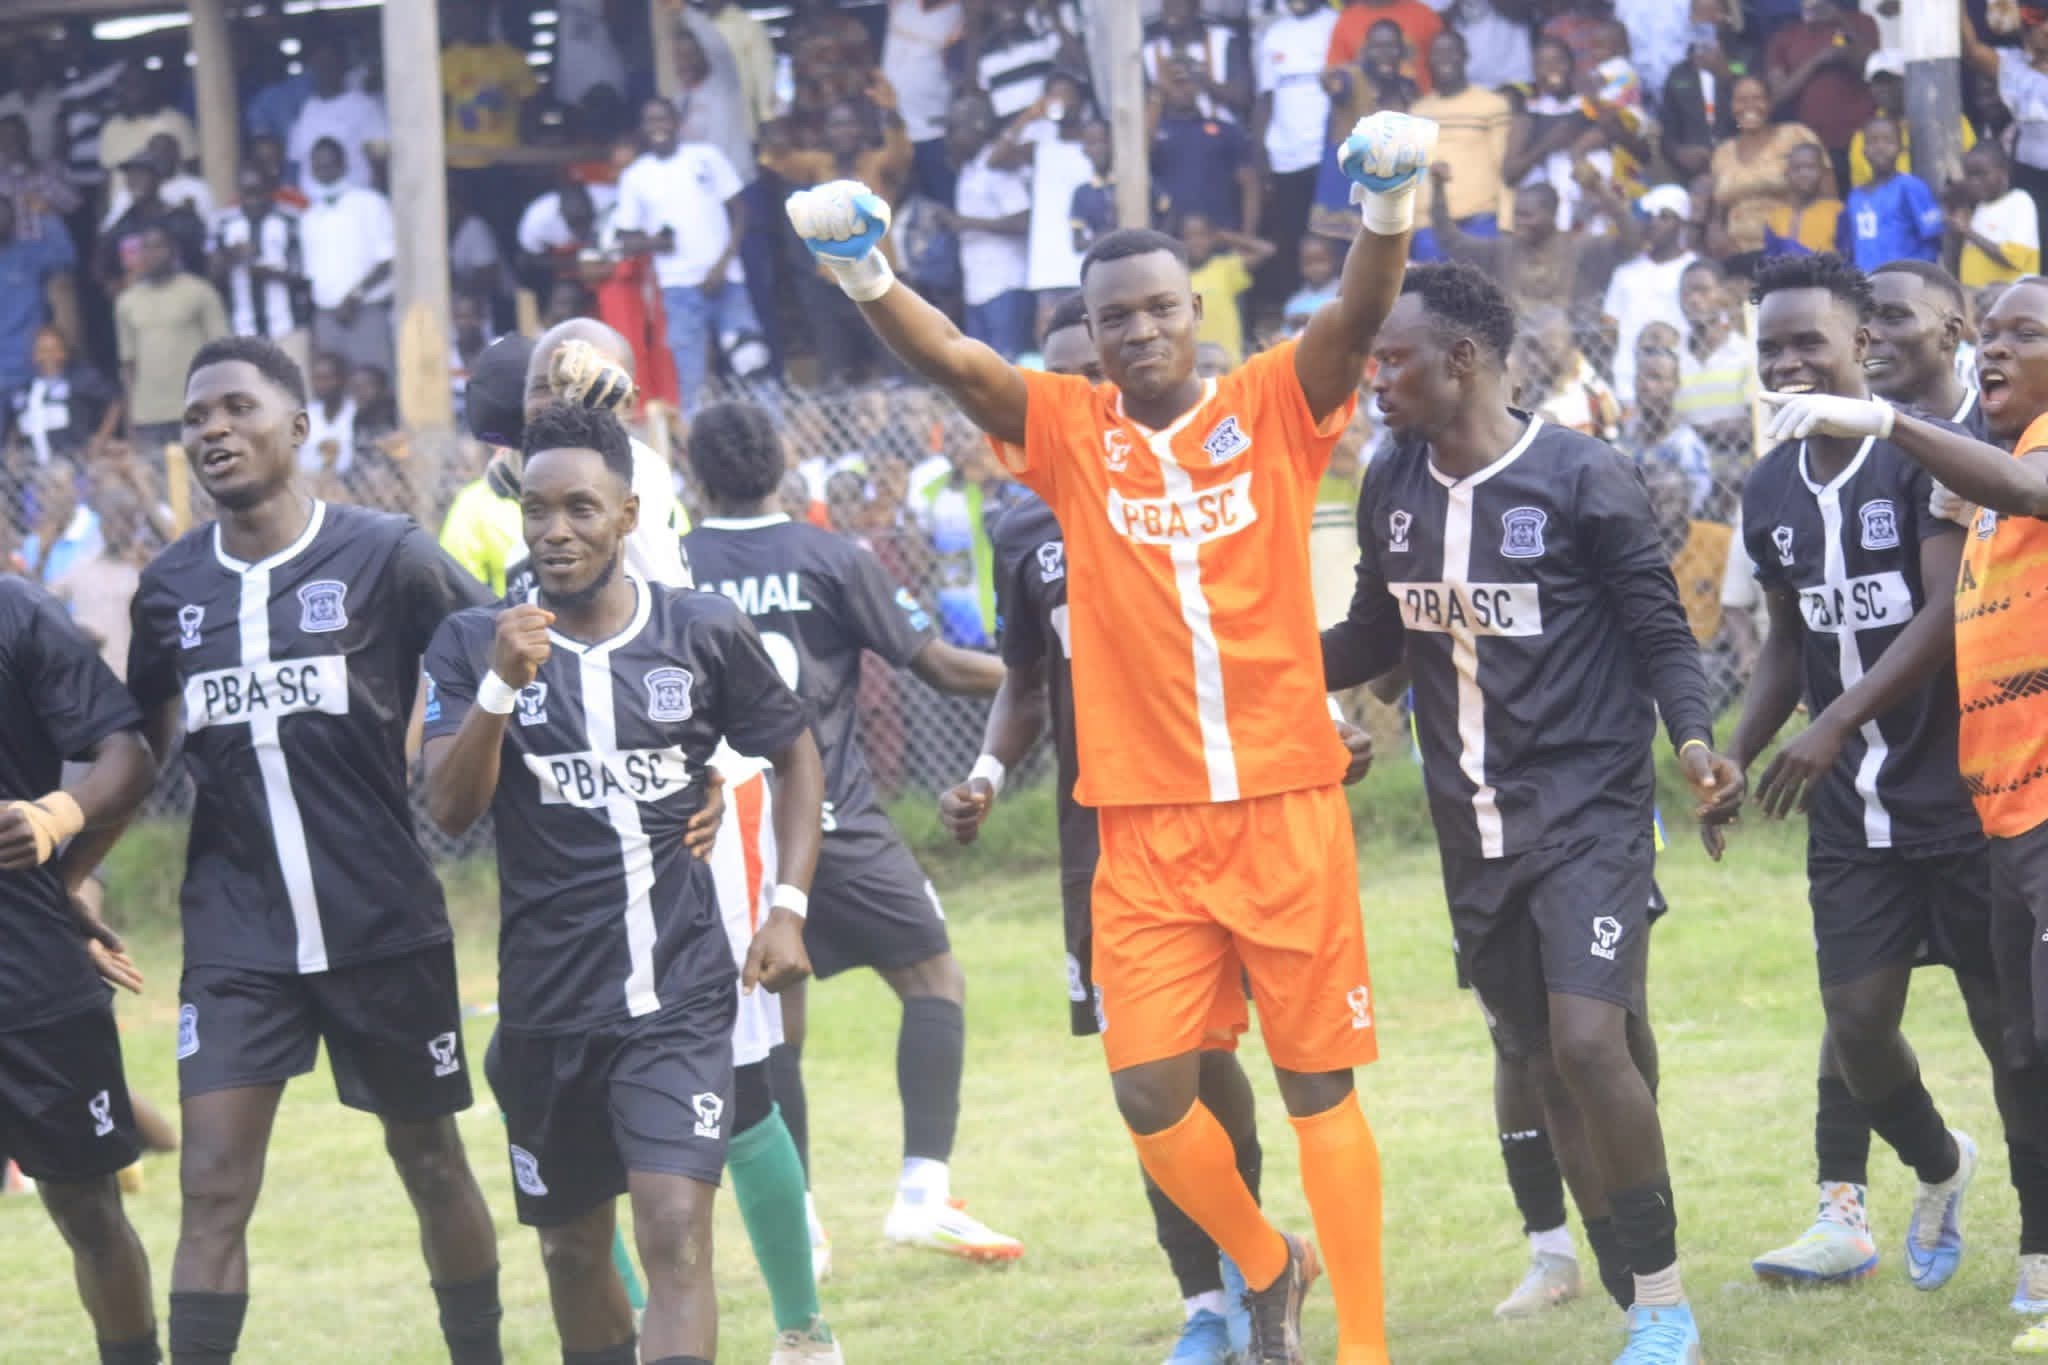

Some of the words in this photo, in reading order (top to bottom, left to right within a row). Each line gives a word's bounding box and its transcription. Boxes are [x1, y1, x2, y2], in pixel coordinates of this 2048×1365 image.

[1122, 501, 1189, 538] PBA
[1199, 489, 1238, 534] SC
[699, 572, 813, 616] MAL
[1472, 588, 1514, 629] SC
[1852, 580, 1887, 622] SC
[203, 672, 269, 720] PBA
[276, 664, 322, 707] SC
[551, 758, 625, 802] PBA
[625, 752, 668, 795] SC
